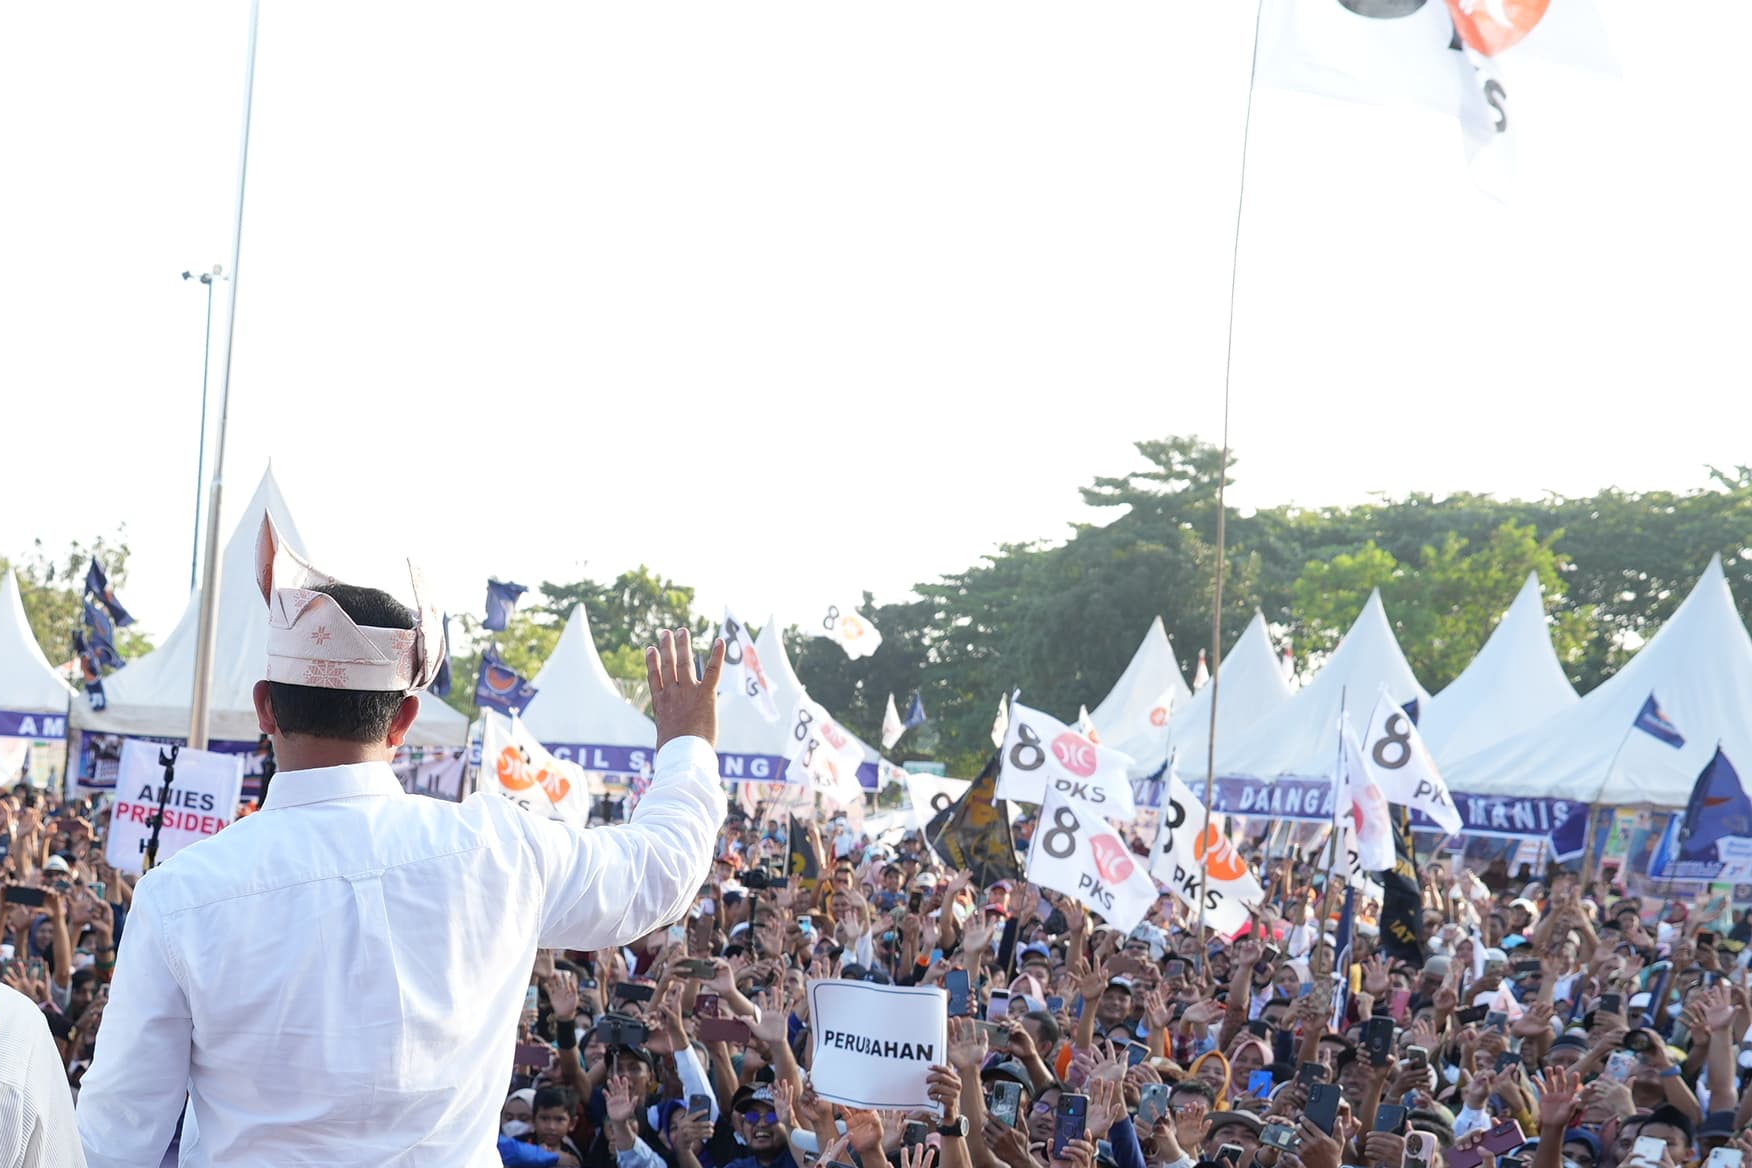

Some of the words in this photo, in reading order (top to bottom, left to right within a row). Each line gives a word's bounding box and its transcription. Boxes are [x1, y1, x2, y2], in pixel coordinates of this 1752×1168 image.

[1009, 723, 1046, 771] 8
[1371, 712, 1412, 770] 8
[138, 784, 215, 811] ANIES
[1042, 806, 1081, 860] 8
[1078, 872, 1116, 912] PKS
[1172, 864, 1224, 910] PKS
[824, 1029, 934, 1062] PERUBAHAN
